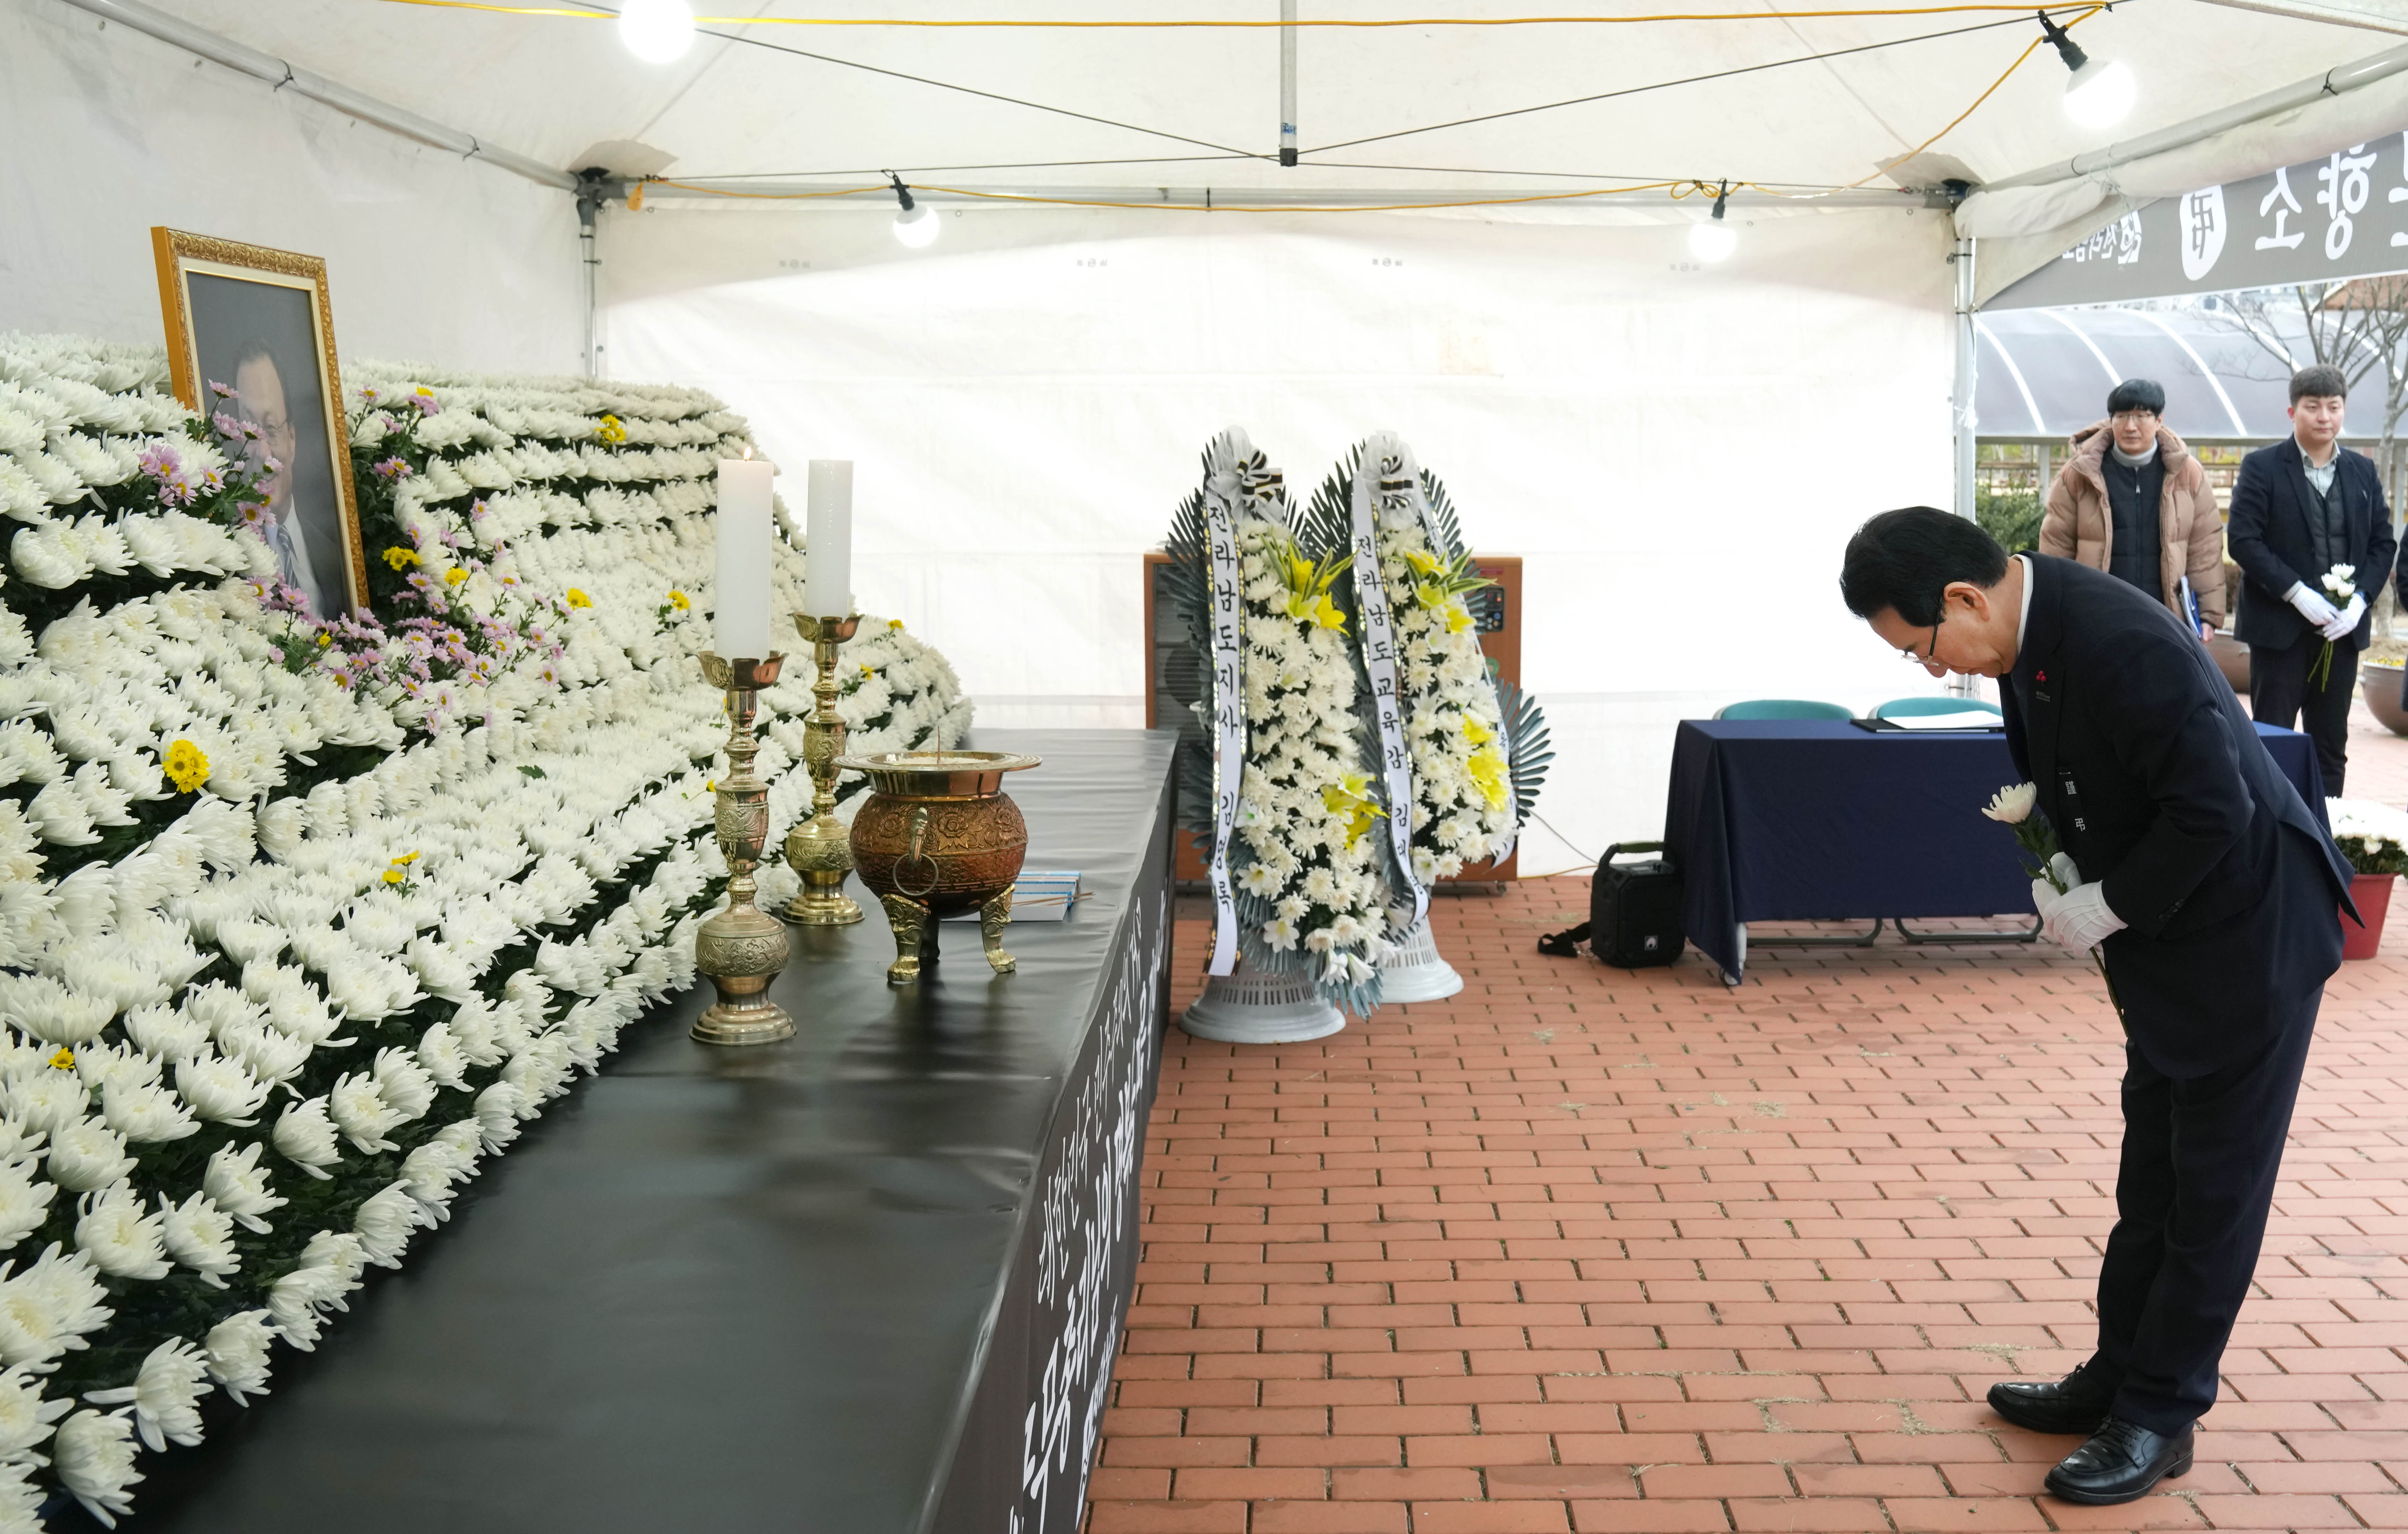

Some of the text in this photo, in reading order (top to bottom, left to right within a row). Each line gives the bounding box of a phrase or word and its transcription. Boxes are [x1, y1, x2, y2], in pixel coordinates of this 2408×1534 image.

[1209, 505, 1238, 914] 전라남도지사 김영록
[1358, 535, 1404, 769] 전라남도교육감
[1038, 1075, 1091, 1310] 대한민국
